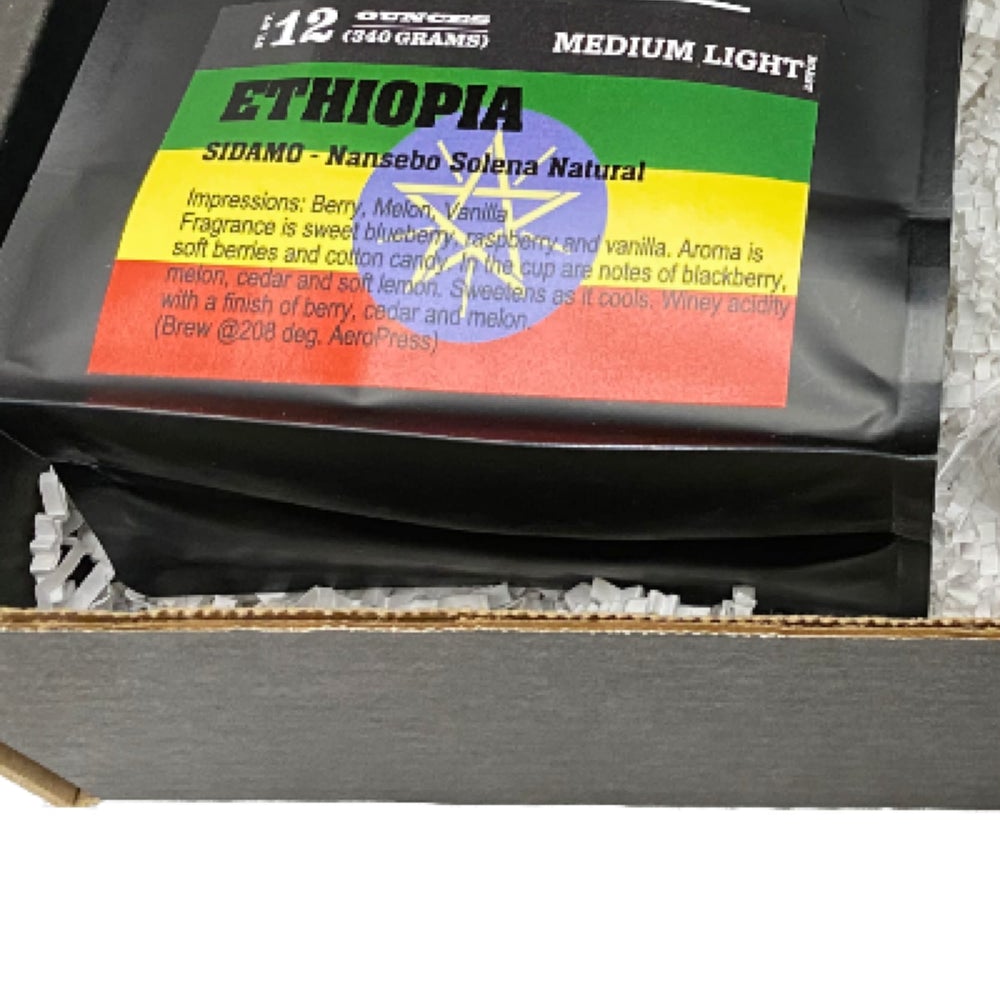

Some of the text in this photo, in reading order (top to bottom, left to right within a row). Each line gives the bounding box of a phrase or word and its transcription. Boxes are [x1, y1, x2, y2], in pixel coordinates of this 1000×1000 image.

[270, 7, 339, 47] 12
[355, 11, 491, 25] OUNCES
[342, 29, 490, 49] (340 GRAMS)
[552, 31, 695, 62] MEDIUM
[702, 46, 806, 79] LIGHT
[220, 77, 523, 132] ETHIOPIA
[202, 141, 304, 163] SIDAMO
[325, 144, 440, 172] Nansebo
[450, 151, 539, 177] Solena
[547, 157, 647, 182] Natural
[187, 187, 507, 223] Impressions: Berry, Melon, Vanilla
[180, 212, 764, 262] Fragrance is sweet blueberry, raspberry and vanilla. Aroma is
[172, 238, 208, 258] soft
[212, 239, 279, 261] berries
[284, 242, 320, 263] and
[325, 244, 384, 268] cotton
[484, 254, 513, 275] the
[520, 259, 554, 282] cup
[561, 261, 592, 279] are
[599, 260, 652, 282] notes
[657, 262, 677, 283] of
[682, 263, 787, 293] blackberry,
[160, 290, 198, 312] with
[204, 294, 217, 311] a
[222, 292, 273, 315] finish
[280, 296, 301, 317] of
[303, 297, 357, 323] berry,
[364, 300, 420, 323] cedar
[425, 303, 461, 326] and
[165, 265, 790, 319] melon, cedar and soft lemon. Sweetens as it cools. Winey acidity
[154, 315, 439, 353] (Brew @208 deg. AeroPress)
